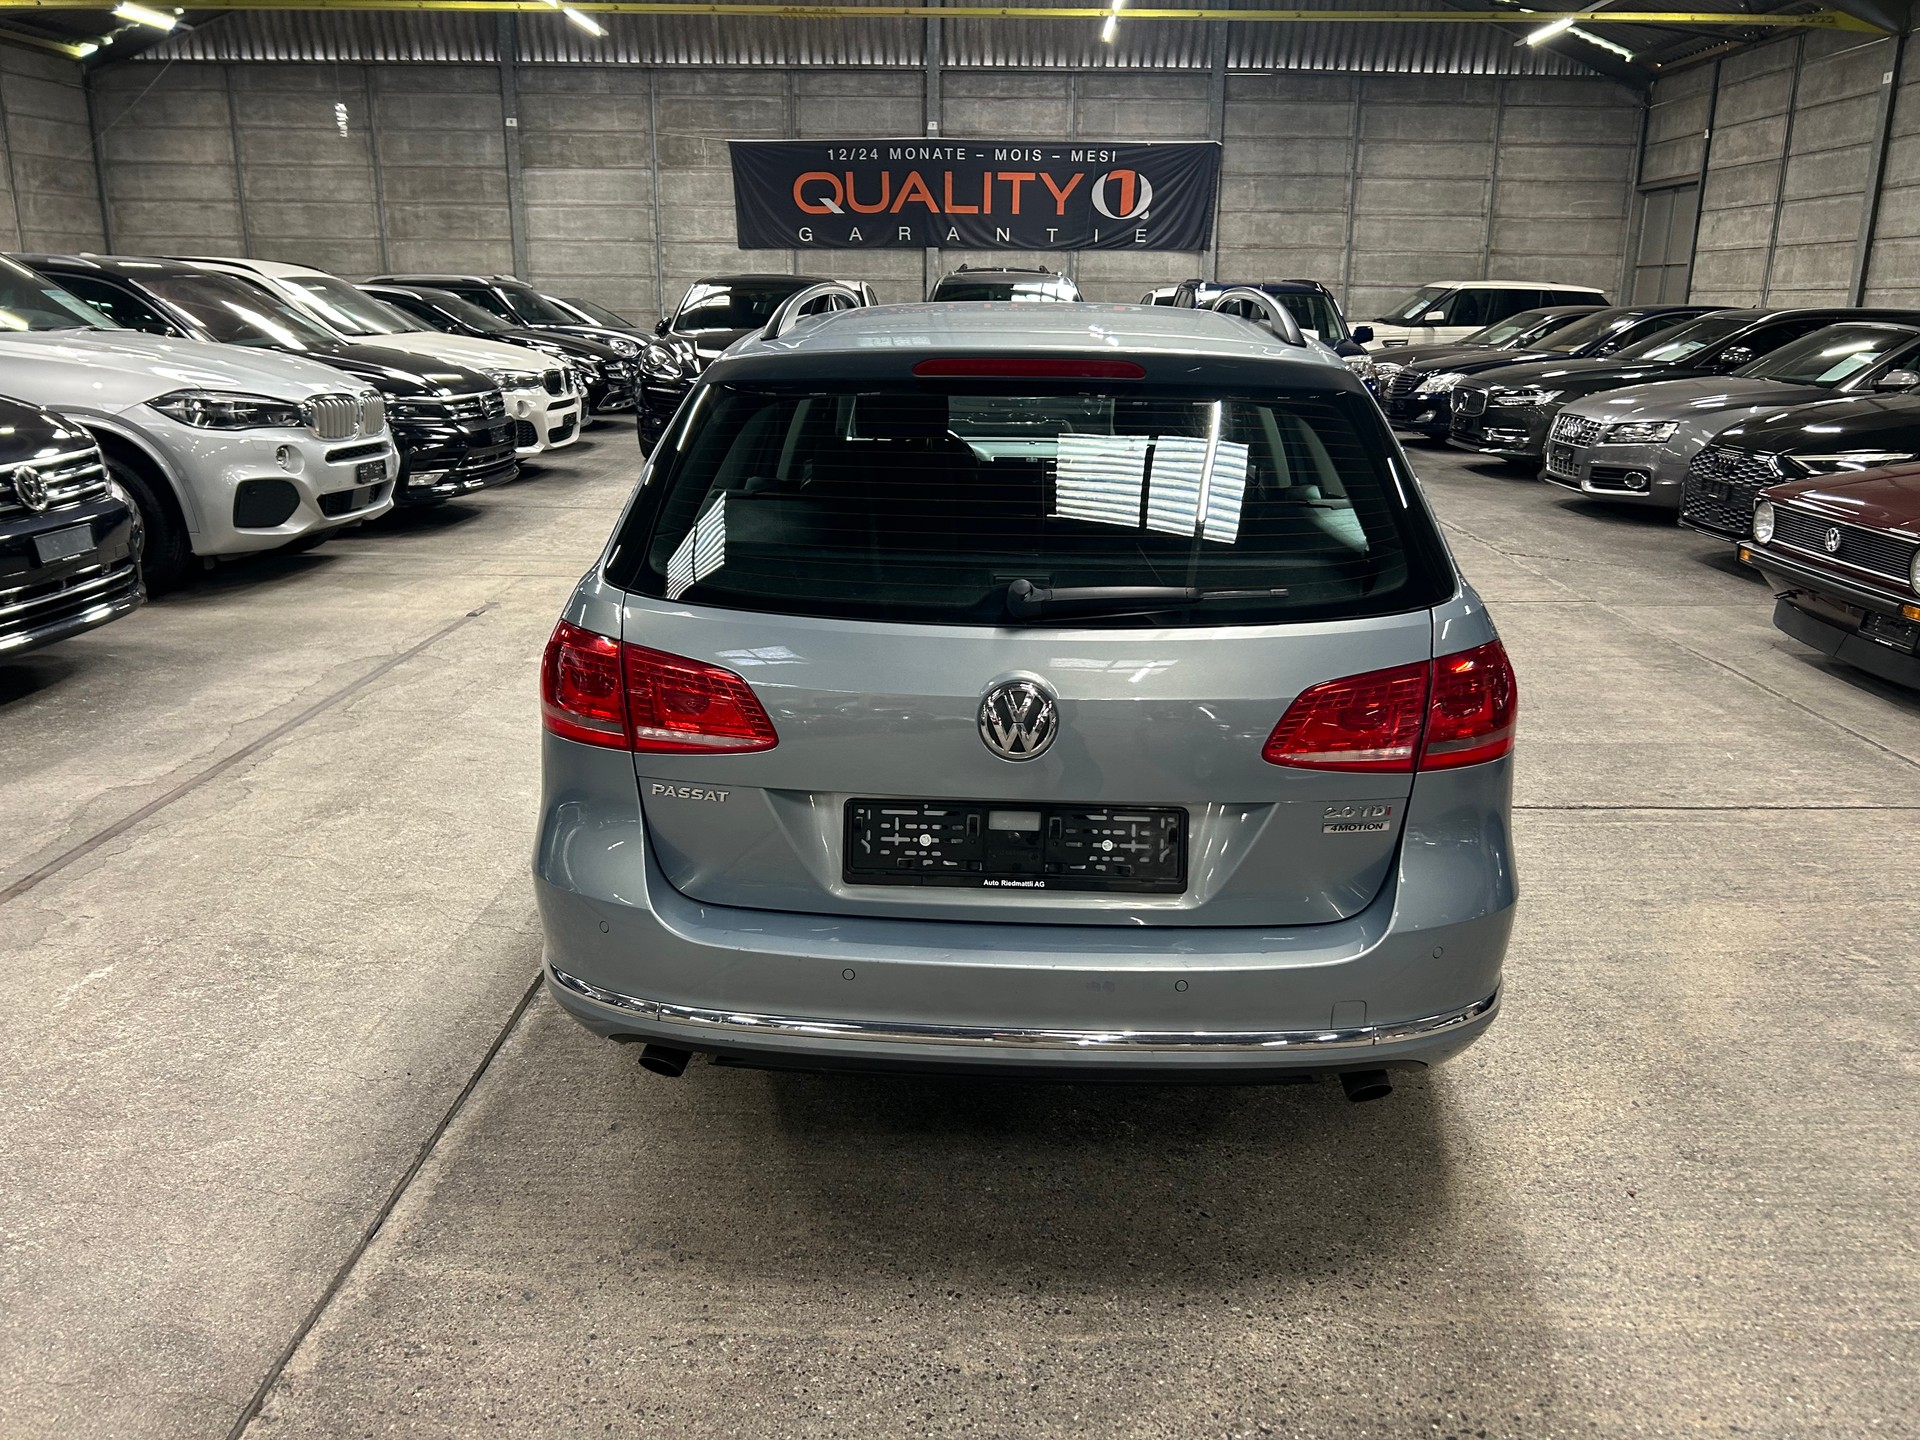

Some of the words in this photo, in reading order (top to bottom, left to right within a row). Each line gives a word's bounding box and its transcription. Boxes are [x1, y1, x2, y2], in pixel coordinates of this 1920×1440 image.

[827, 148, 879, 161] 12/24
[889, 147, 966, 162] MONATE
[994, 149, 1042, 162] MOIS
[1070, 149, 1118, 163] MESI
[793, 170, 1085, 215] QUALITY
[798, 226, 1149, 244] GARANTIE
[651, 783, 730, 803] PASSAT
[1359, 804, 1392, 817] TDI
[1330, 822, 1384, 832] 4MOTION
